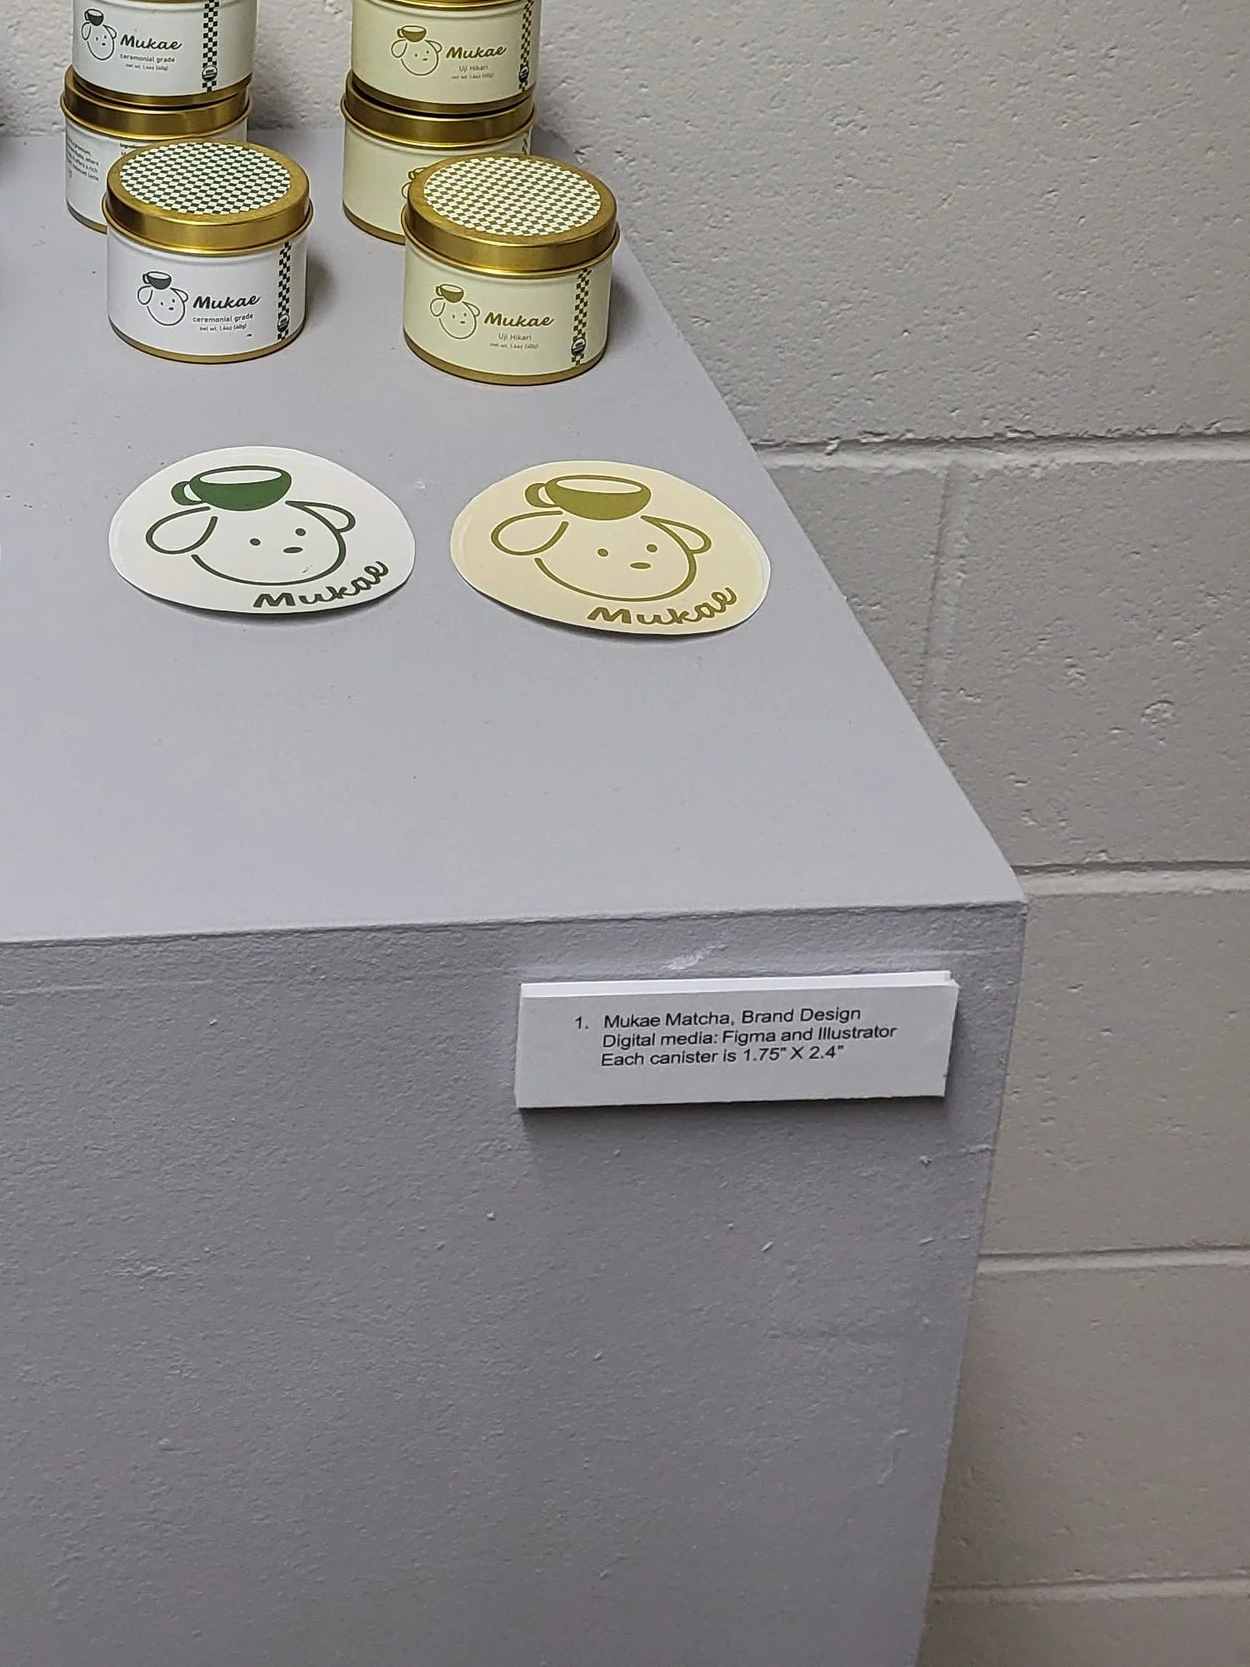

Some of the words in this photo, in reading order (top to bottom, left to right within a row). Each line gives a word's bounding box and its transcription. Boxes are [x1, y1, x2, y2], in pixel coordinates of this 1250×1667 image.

[120, 34, 182, 50] Mukae
[120, 54, 154, 62] ceremonial
[446, 45, 506, 59] Mukae
[193, 294, 260, 309] Mukae
[234, 314, 253, 322] grade
[484, 311, 554, 327] Mukae
[252, 560, 389, 609] Mukae
[587, 585, 737, 627] Mukae
[575, 1016, 588, 1029] 1.
[603, 1013, 660, 1029] Mukae
[665, 1011, 735, 1028] Matcha,
[741, 1009, 793, 1024] Brand
[800, 1007, 861, 1024] Design
[603, 1032, 655, 1049] Digital
[660, 1031, 718, 1046] media:
[723, 1029, 775, 1047] Figma
[780, 1027, 813, 1042] and
[818, 1024, 897, 1040] Illustrator
[601, 1052, 644, 1066] Each
[650, 1049, 718, 1065] canister
[723, 1048, 737, 1063] is
[790, 1046, 803, 1059] X
